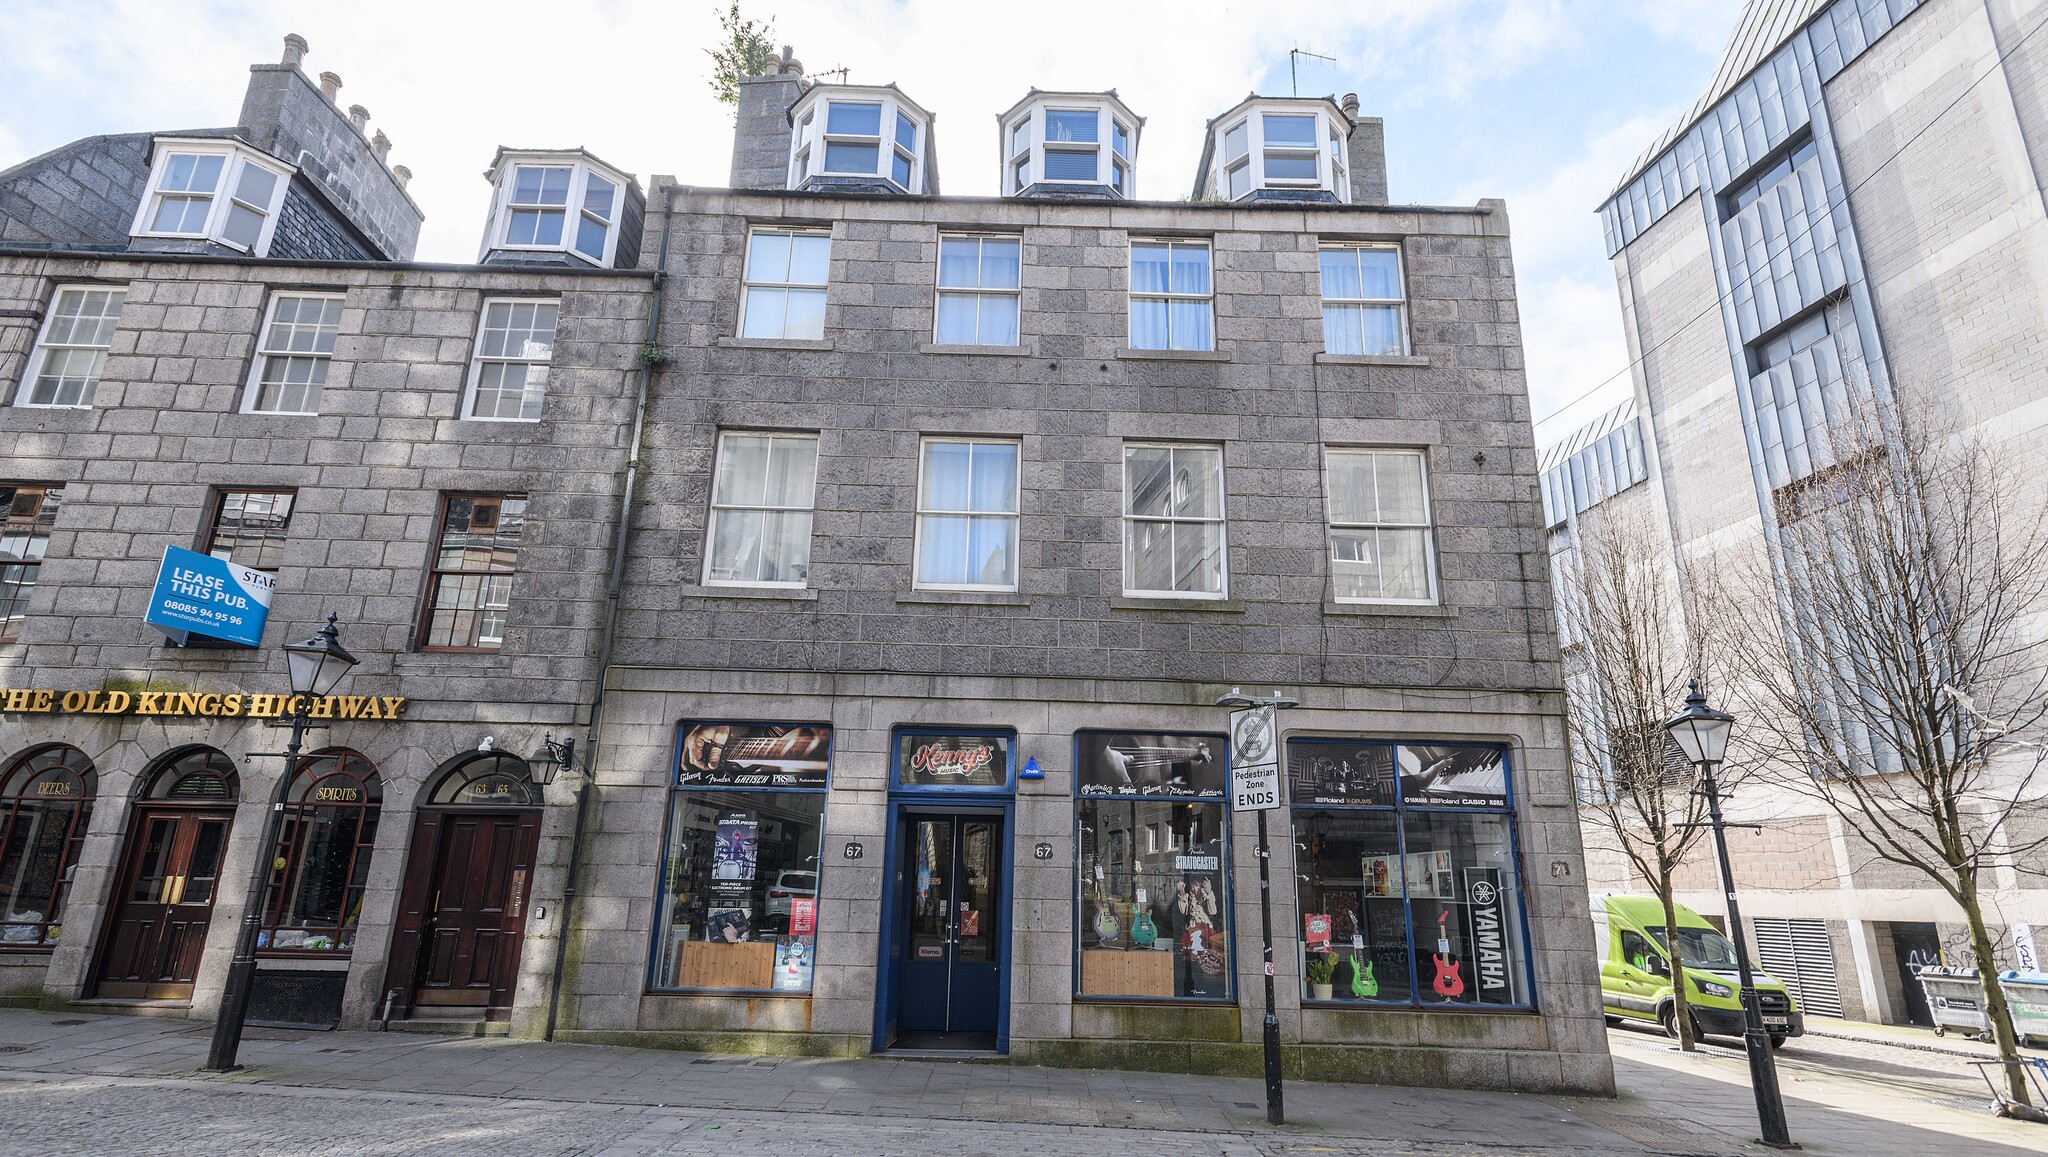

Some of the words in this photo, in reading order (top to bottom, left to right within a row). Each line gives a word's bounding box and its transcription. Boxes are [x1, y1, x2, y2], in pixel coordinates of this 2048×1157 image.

[173, 567, 225, 590] LEASE
[171, 579, 212, 599] THIS
[214, 591, 249, 610] PUB.
[162, 610, 220, 627] www.starpubs.co.uk
[164, 600, 198, 614] 08085
[200, 608, 213, 618] 94
[215, 612, 228, 622] 95
[230, 616, 242, 625] 96
[62, 690, 131, 713] OLD
[135, 692, 242, 717] KINGS
[248, 694, 405, 719] HIGHWAY
[911, 743, 994, 776] Kenny's
[680, 772, 701, 785] Gibson
[705, 773, 731, 784] Fender
[734, 775, 769, 784] GRETSCH
[773, 774, 788, 783] PRS
[1235, 768, 1275, 780] Pedestrian
[37, 782, 70, 795] BEERS
[475, 784, 487, 794] 63
[497, 784, 508, 794] 65
[1142, 785, 1162, 796] Gibson
[1246, 780, 1265, 789] Zone
[316, 787, 357, 800] SPIRITS
[1238, 791, 1274, 806] ENDS
[846, 846, 861, 857] 67
[1036, 847, 1052, 857] 67
[1187, 847, 1205, 855] Fender
[1175, 855, 1218, 870] STRATOCASTER
[1474, 907, 1505, 990] YAMAHA
